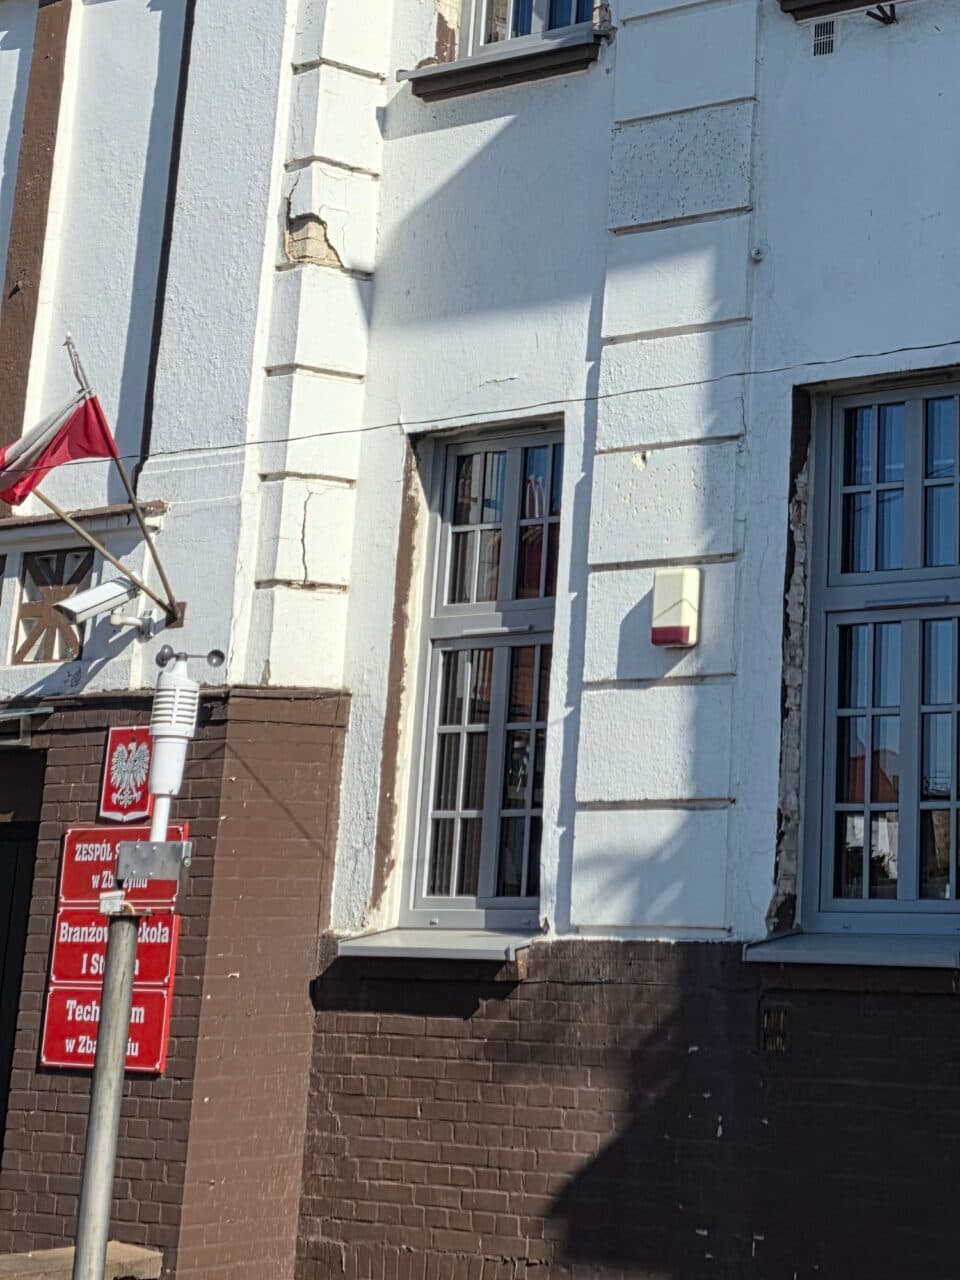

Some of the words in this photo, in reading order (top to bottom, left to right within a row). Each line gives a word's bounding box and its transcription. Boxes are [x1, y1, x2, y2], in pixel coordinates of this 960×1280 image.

[75, 839, 113, 862] ZESPÓŁ
[92, 874, 100, 889] w
[137, 922, 170, 943] zkoła
[81, 953, 88, 975] I
[66, 1000, 145, 1024] Techm
[65, 1038, 76, 1053] w
